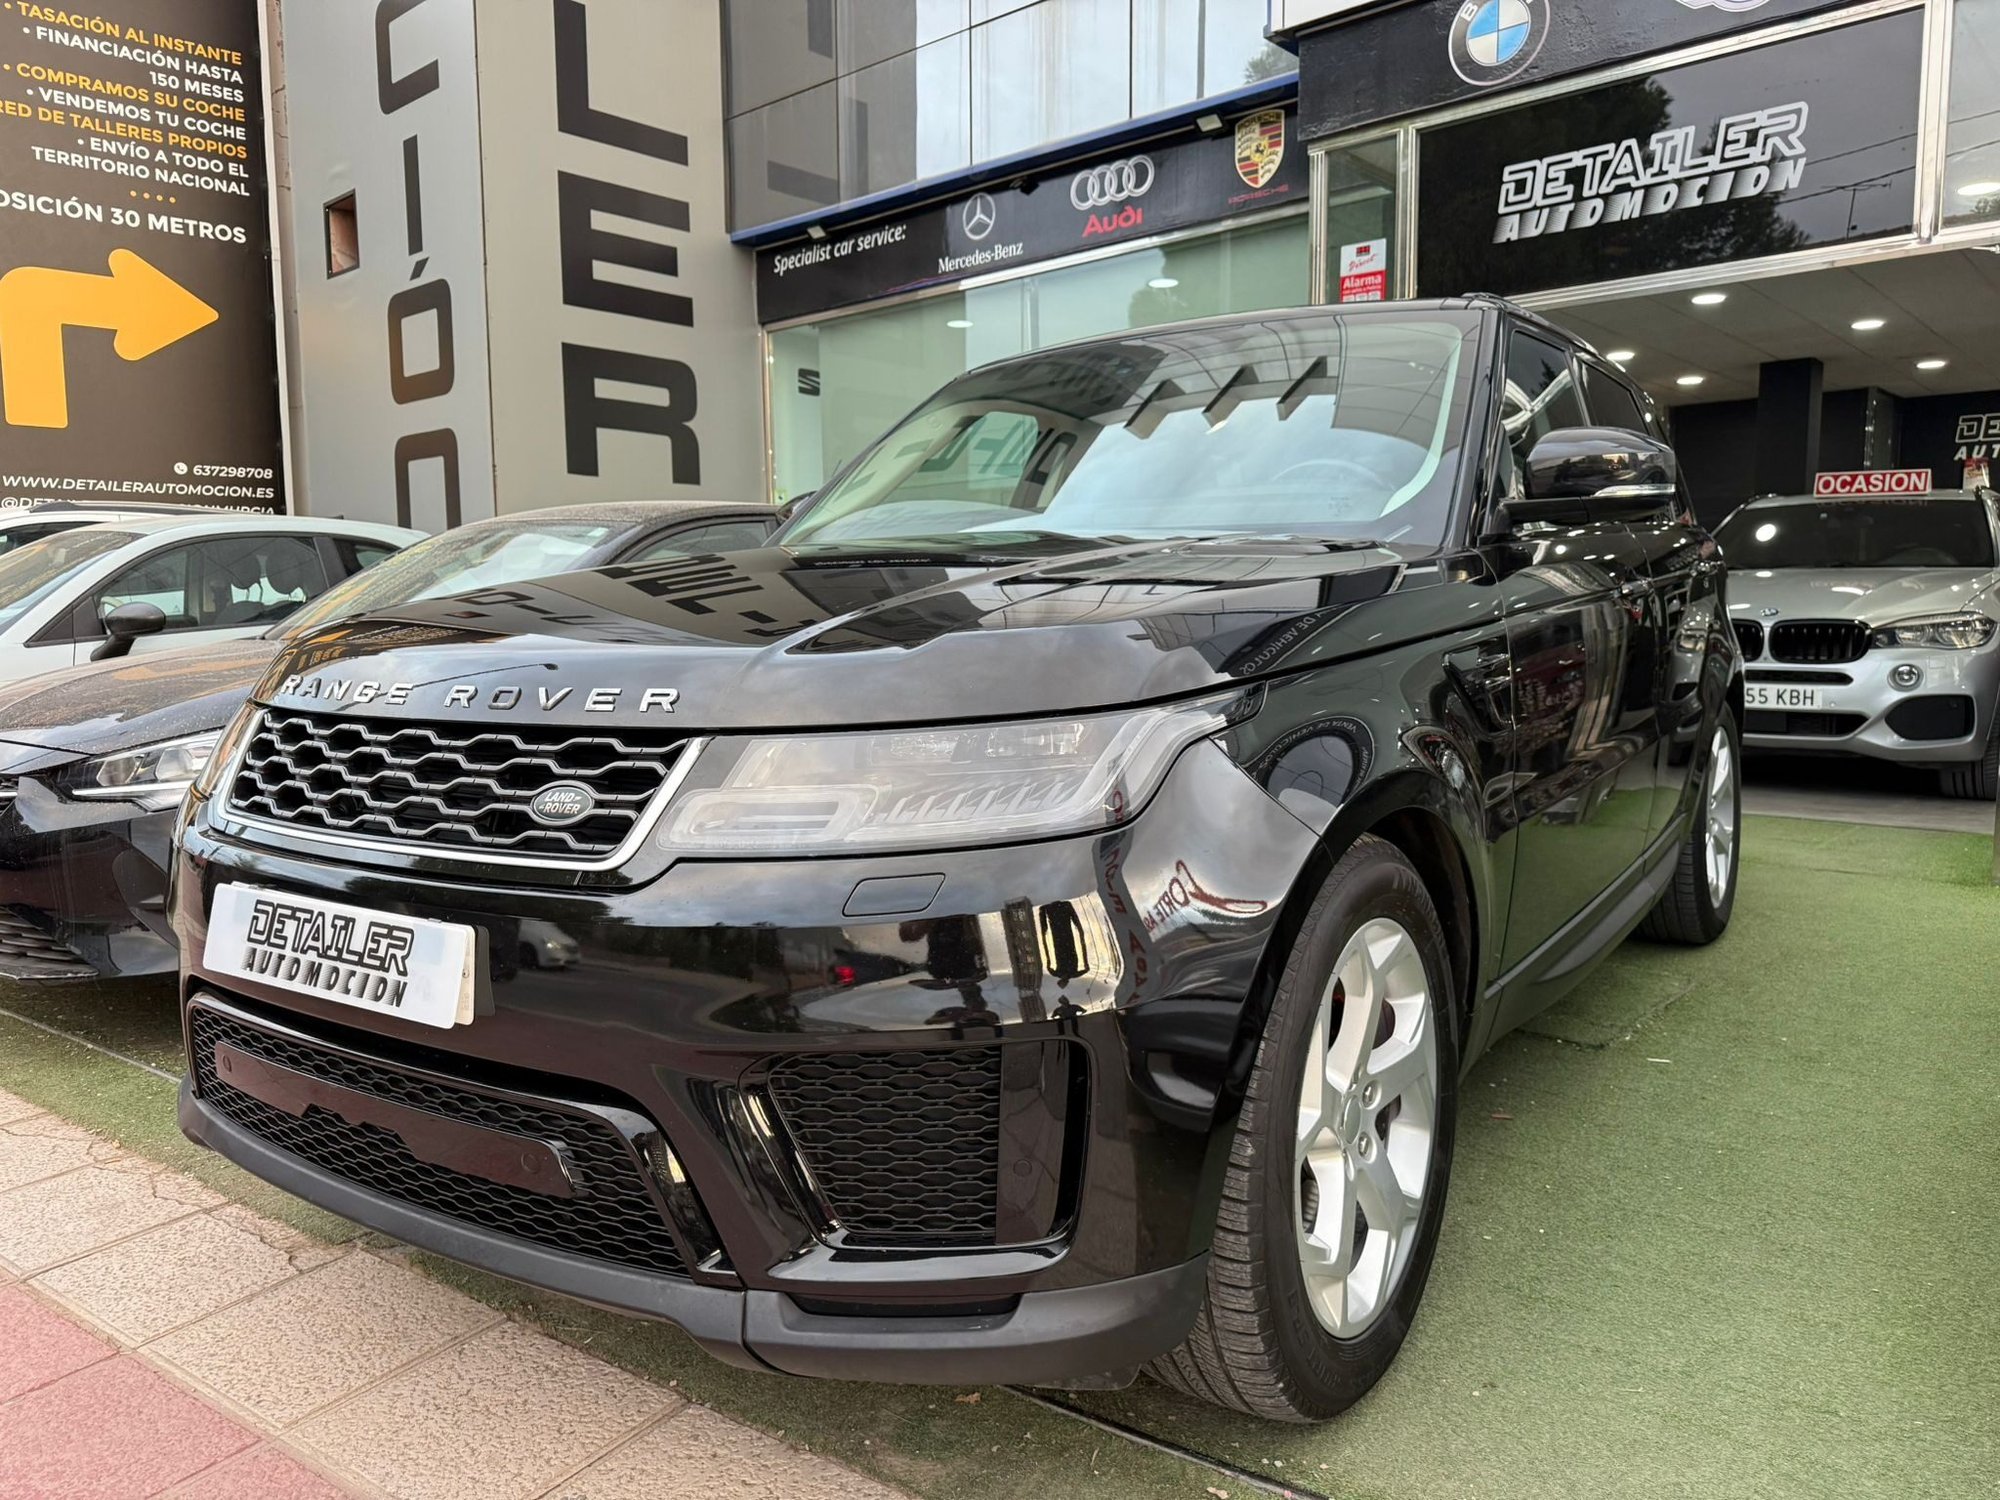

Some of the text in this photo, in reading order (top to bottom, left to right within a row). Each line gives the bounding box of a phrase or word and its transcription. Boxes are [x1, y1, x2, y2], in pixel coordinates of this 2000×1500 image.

[17, 1, 242, 65] TASACIÓN AL INSTANTE
[37, 26, 244, 84] FINANCIACIÓN HASTA
[17, 63, 246, 122] COMPRAMOS SU COCHE
[149, 71, 244, 103] 150 MESES
[38, 107, 65, 125] DE
[70, 113, 163, 143] TALLERES
[168, 132, 248, 159] PROPIOS
[39, 87, 246, 140] VENDEMOS TU COCHE
[31, 146, 250, 196] TERRITORIO NACIONAL
[90, 134, 249, 178] ENVÍO A TODO EL
[1498, 101, 1808, 214] DETAILER
[1492, 157, 1806, 244] AUTOMOCION
[110, 207, 140, 228] 30
[147, 213, 248, 244] METROS
[1082, 206, 1143, 238] Audi
[773, 224, 906, 277] Specialist car service:
[938, 242, 1023, 274] Mercedes-Benz
[1342, 274, 1382, 290] Alarma
[2, 475, 275, 499] WWW.DETAILERAUTOMOCION.ES
[193, 464, 274, 480] 637298708
[1818, 472, 1926, 494] OCASION
[280, 673, 681, 714] RANGE ROVER
[1776, 688, 1814, 706] KBH
[543, 802, 581, 814] ROVER
[544, 791, 576, 802] LAND
[247, 899, 415, 977] DETAILER
[240, 946, 408, 1008] AUTOMOCION
